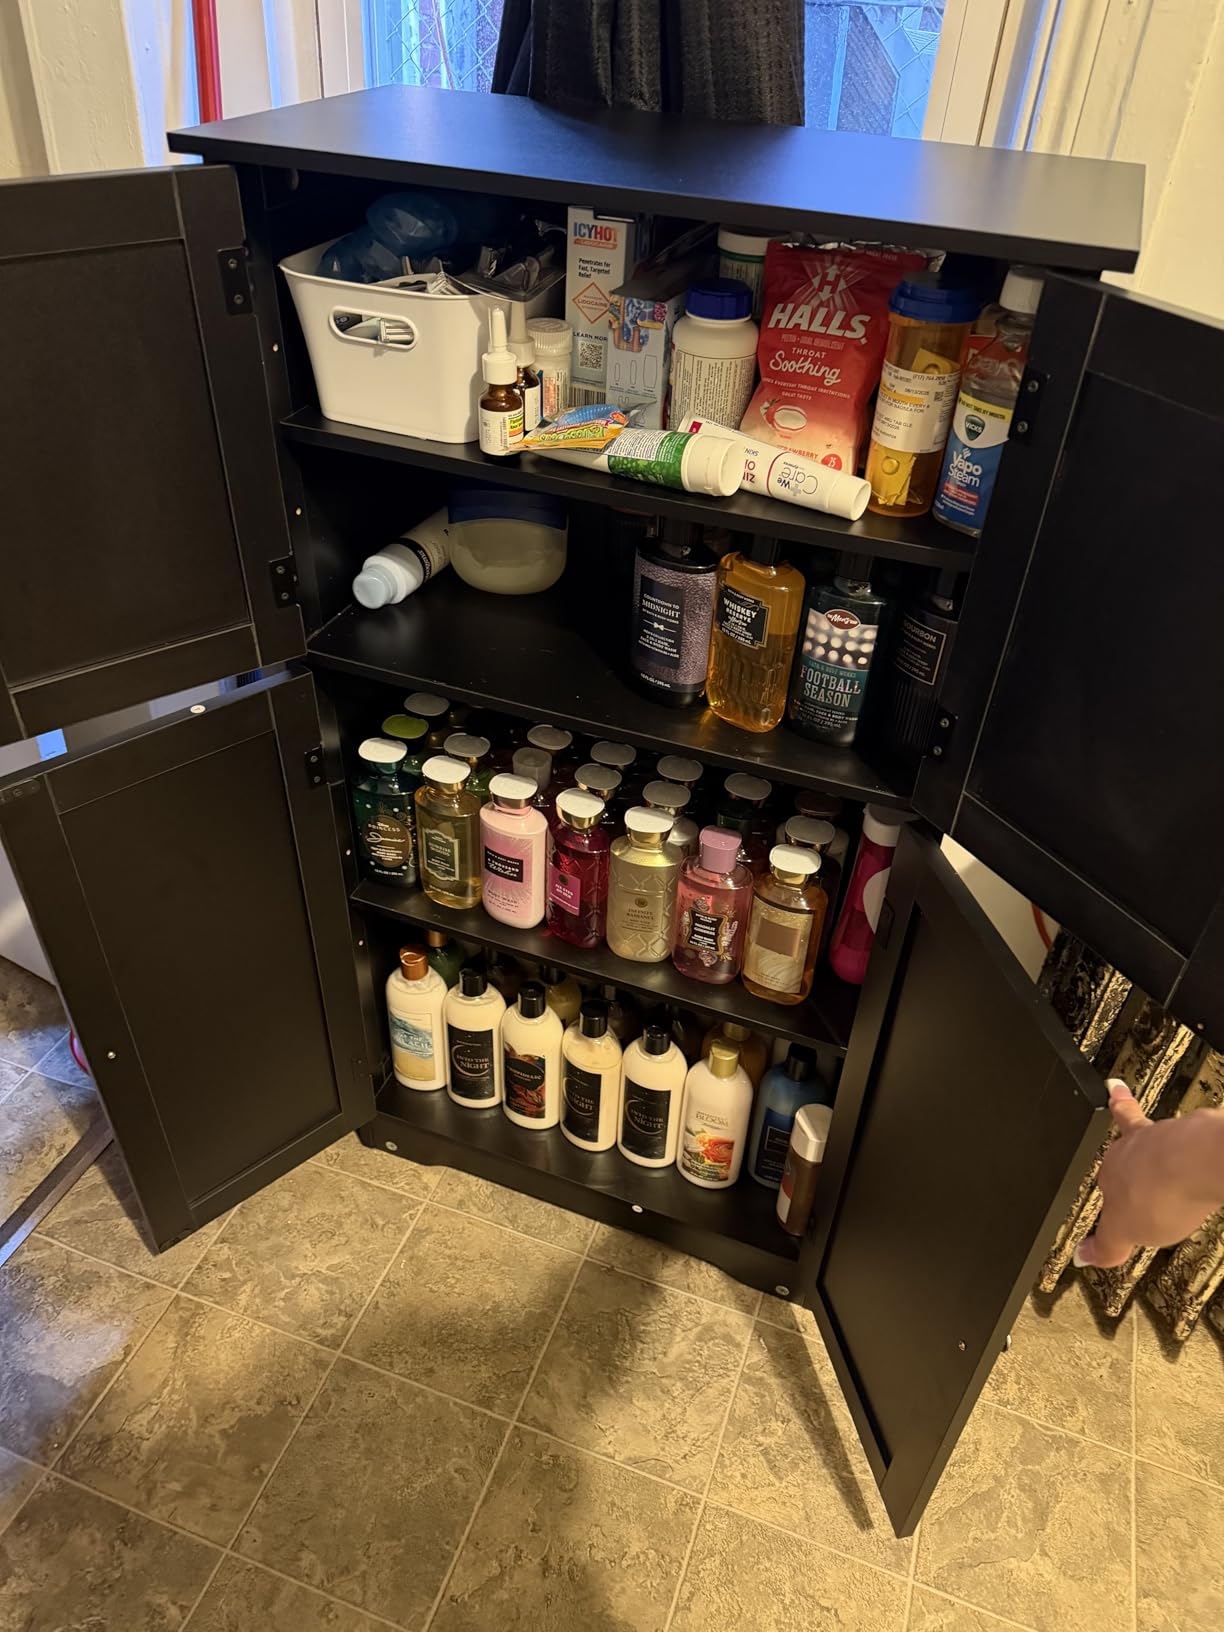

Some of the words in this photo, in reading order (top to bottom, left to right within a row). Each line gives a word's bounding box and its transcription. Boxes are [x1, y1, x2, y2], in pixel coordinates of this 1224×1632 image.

[579, 258, 603, 267] Penetrates
[590, 267, 611, 275] Targeted
[767, 303, 872, 341] HALLS
[573, 332, 593, 341] LEARN
[792, 347, 827, 359] THROAT
[769, 350, 842, 386] Soothing
[965, 421, 983, 434] VICKS
[953, 450, 983, 476] Vapo
[776, 477, 792, 489] We
[779, 466, 819, 495] Care
[948, 463, 980, 487] Steam
[642, 599, 681, 618] MIDNIGHT
[643, 593, 672, 608] COUNTDOWN
[723, 597, 758, 619] WHISKEY
[726, 607, 752, 624] RESERVE
[800, 664, 862, 696] FOOTBALL
[803, 682, 852, 709] SEASON
[457, 1055, 474, 1063] INTO
[460, 1061, 490, 1070] NIGHT
[634, 1116, 665, 1129] NIGHT
